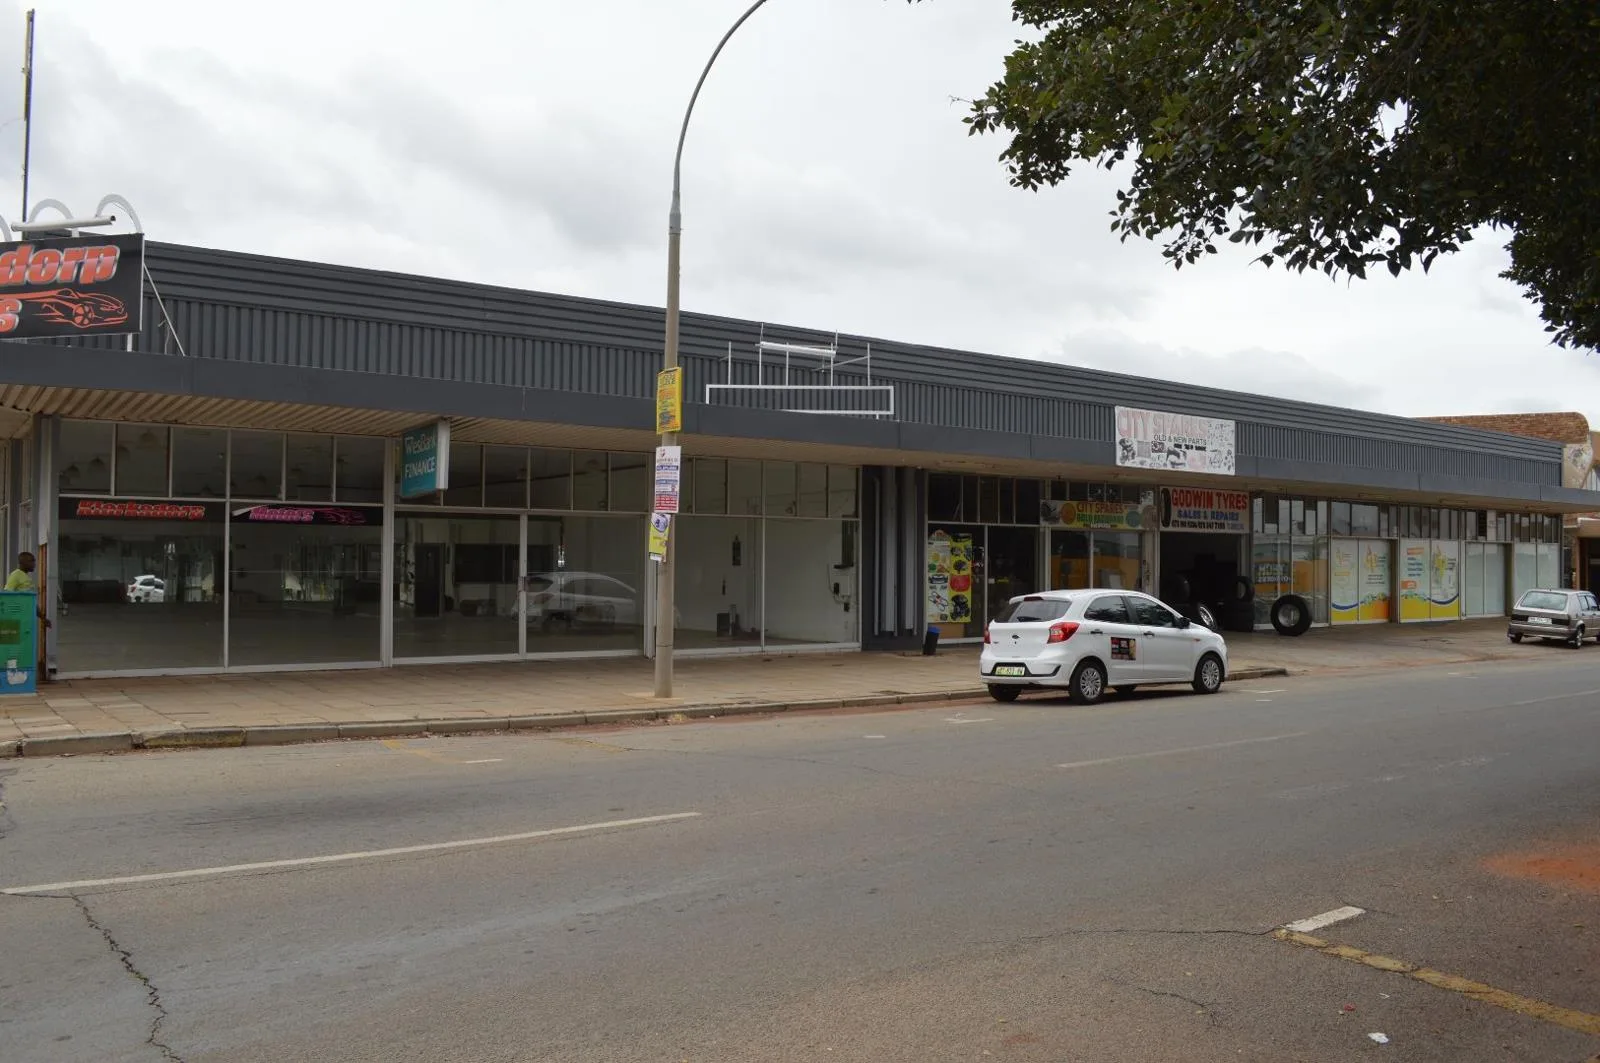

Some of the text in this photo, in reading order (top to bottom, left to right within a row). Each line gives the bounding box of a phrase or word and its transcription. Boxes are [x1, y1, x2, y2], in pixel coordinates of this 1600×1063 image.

[1154, 434, 1167, 442] OLD
[1173, 436, 1187, 444] NEW
[1188, 437, 1207, 446] PARTS
[405, 456, 436, 478] FINANCE
[1171, 488, 1248, 511] GODWIN TYRES
[1177, 509, 1201, 519] SALES
